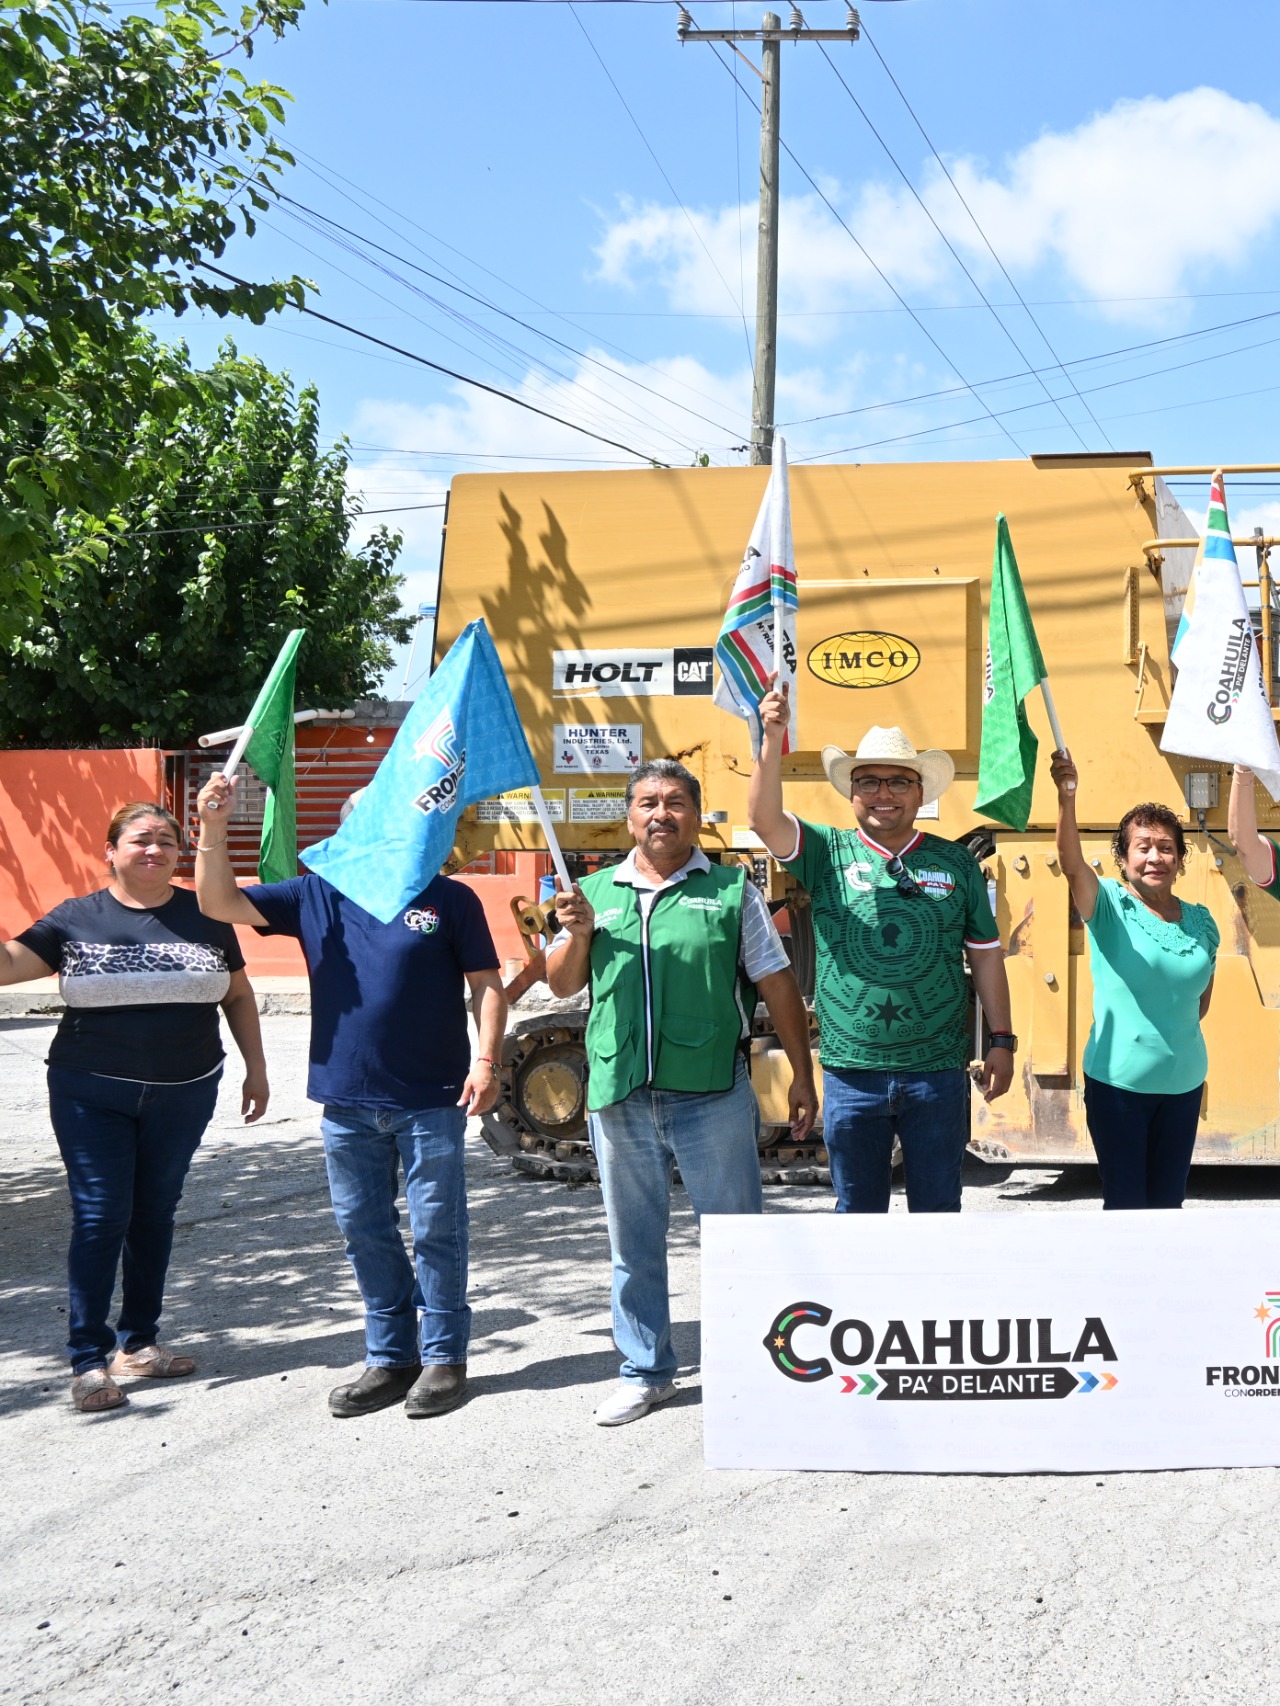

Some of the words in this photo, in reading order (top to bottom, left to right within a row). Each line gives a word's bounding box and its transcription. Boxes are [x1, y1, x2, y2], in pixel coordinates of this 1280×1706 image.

[822, 650, 909, 670] IMCO
[1239, 637, 1251, 673] DELANTE
[564, 661, 663, 683] HOLT
[677, 661, 708, 682] CAT
[1206, 618, 1247, 725] COAHUILA
[568, 728, 627, 738] HUNTER
[506, 792, 533, 800] WARNI
[762, 1301, 1119, 1383] COAHUILA
[942, 1373, 1056, 1394] DELANTE
